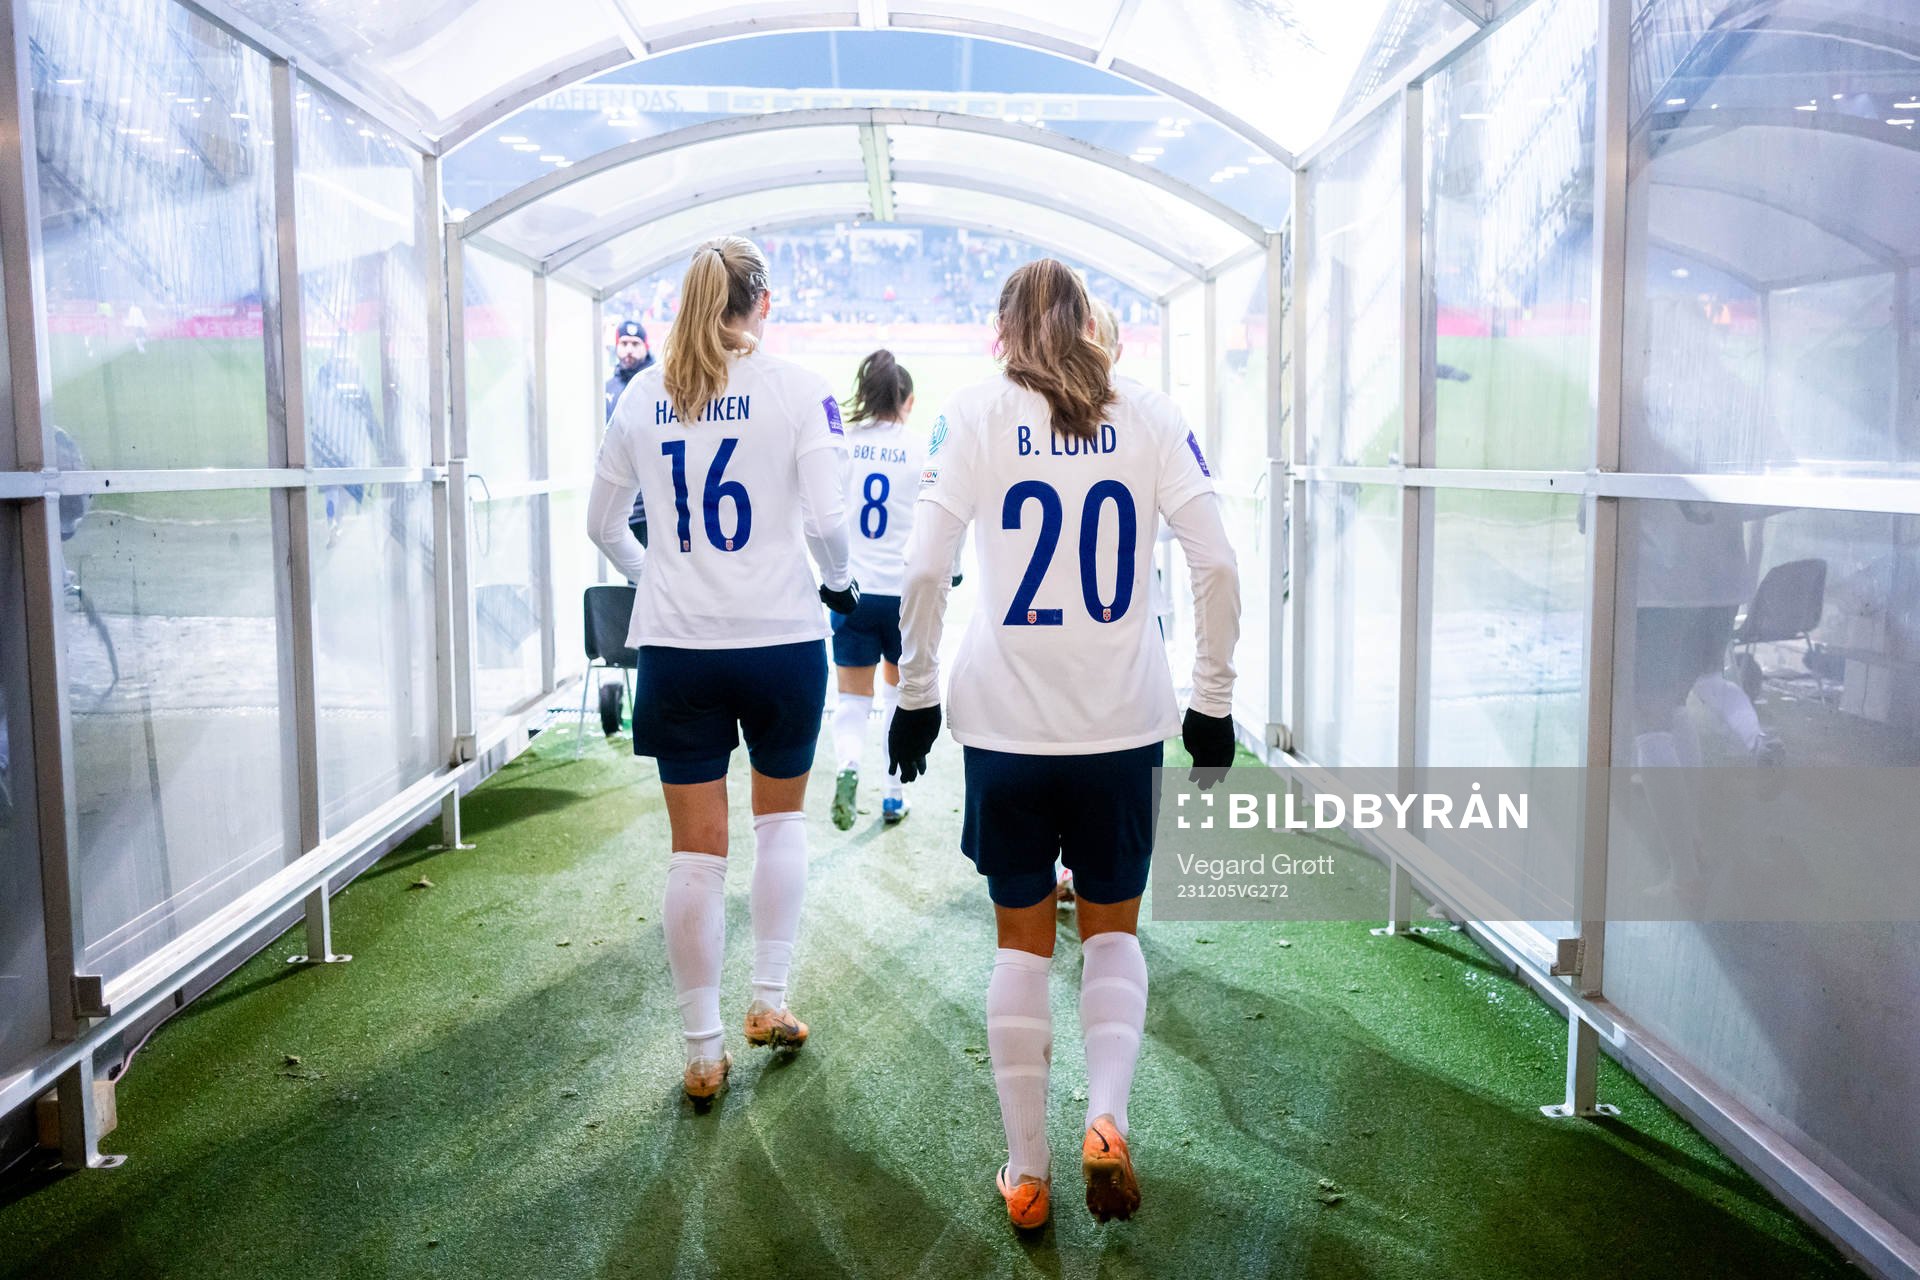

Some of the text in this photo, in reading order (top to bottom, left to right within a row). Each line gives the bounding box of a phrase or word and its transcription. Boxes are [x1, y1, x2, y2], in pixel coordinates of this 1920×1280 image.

[656, 395, 750, 425] HAIKEN
[854, 445, 907, 464] BØE RISA
[1017, 424, 1117, 456] B. LUND
[661, 438, 752, 553] 16
[860, 472, 890, 540] 8
[1002, 479, 1137, 626] 20
